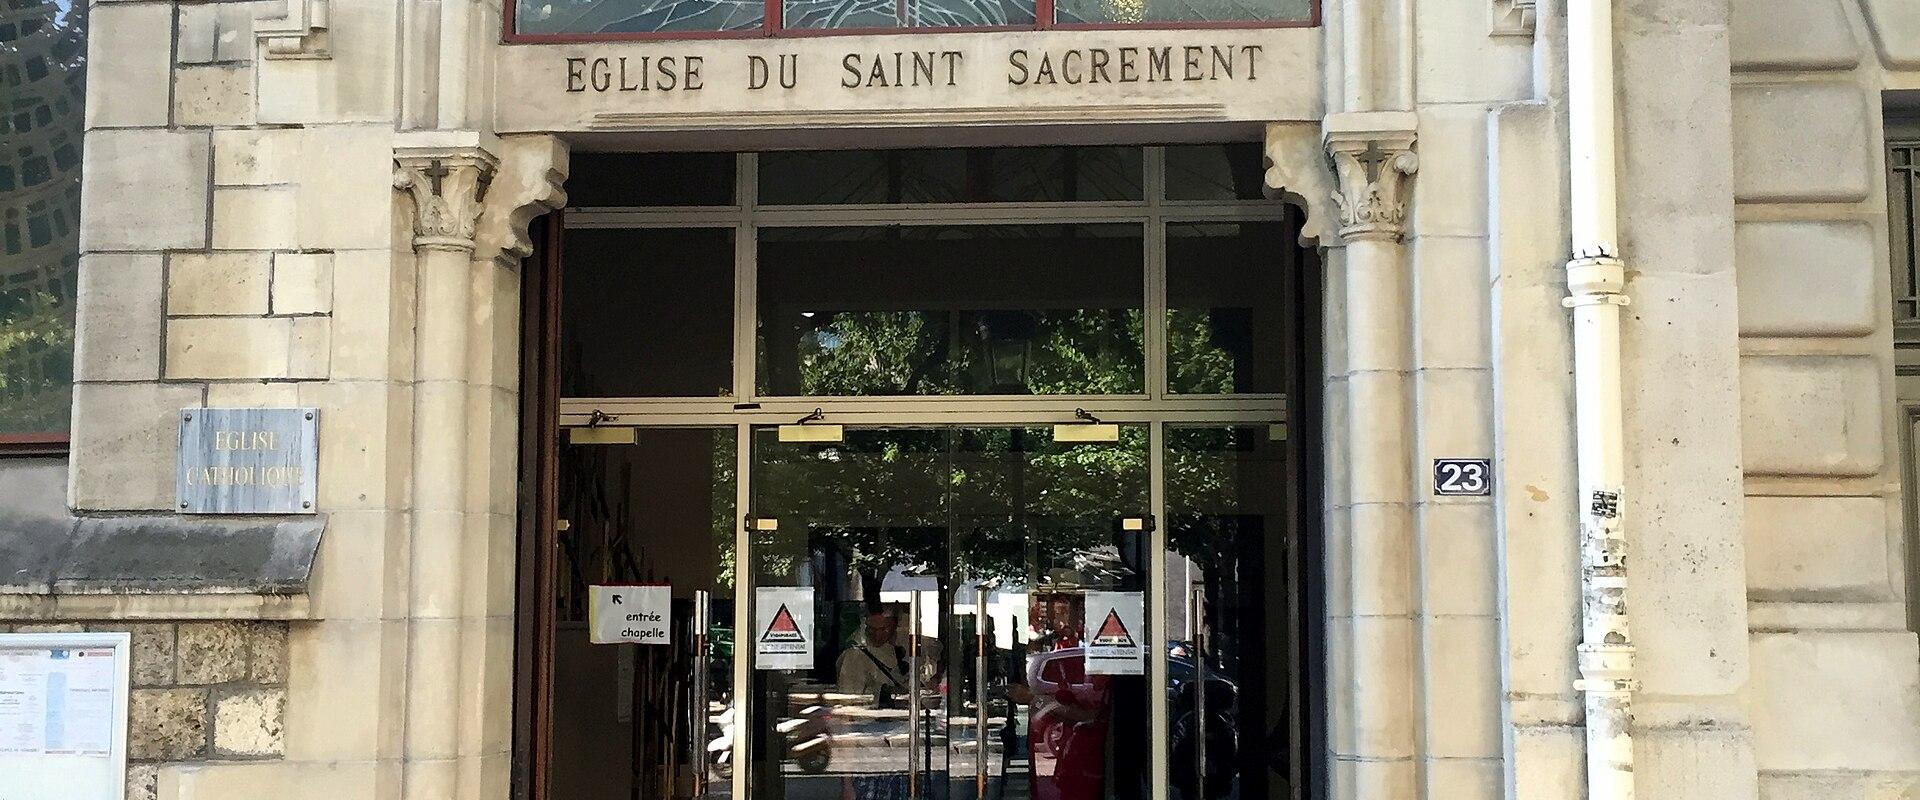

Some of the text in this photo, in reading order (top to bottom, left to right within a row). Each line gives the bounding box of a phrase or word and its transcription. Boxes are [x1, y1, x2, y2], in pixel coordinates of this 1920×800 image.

[566, 45, 1263, 93] EGLISE DU SAINT SACREMENT
[215, 431, 279, 451] EGLISE
[1441, 464, 1483, 491] 23
[626, 611, 662, 622] entrée
[621, 627, 665, 640] chapelle
